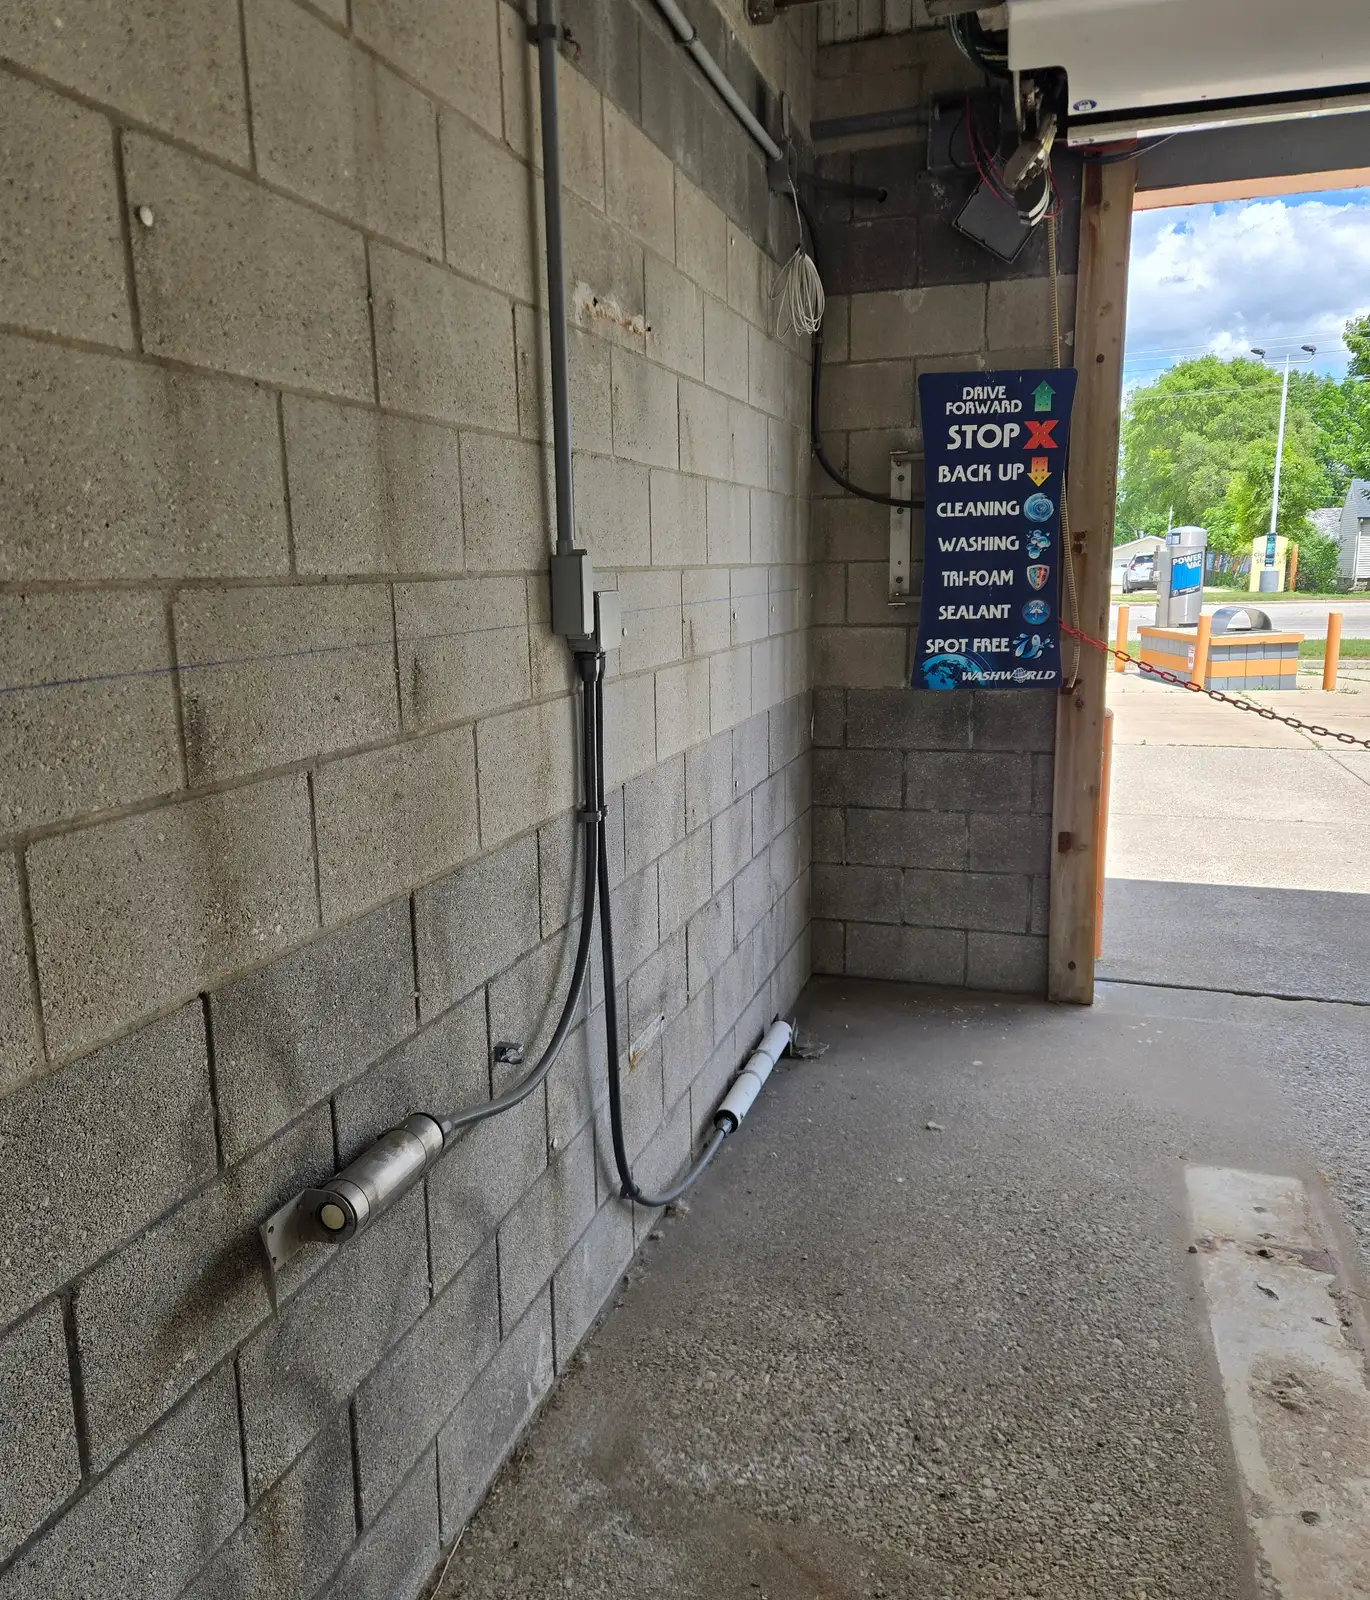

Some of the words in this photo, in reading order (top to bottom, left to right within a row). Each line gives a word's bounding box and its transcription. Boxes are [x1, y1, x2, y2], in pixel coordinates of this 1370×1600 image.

[963, 386, 1007, 400] DRIVE
[946, 400, 1022, 415] FORWARD
[947, 423, 1020, 450] STOP
[938, 464, 992, 483] BACK
[999, 463, 1025, 481] UP
[937, 501, 1020, 517] CLEANING
[938, 536, 1019, 552] WASHING
[1173, 553, 1202, 566] POWER
[1187, 560, 1202, 569] VAC
[942, 570, 1014, 587] TRI-FOAM
[939, 605, 1011, 620] SEALANT
[926, 639, 968, 653] SPOT
[973, 638, 1010, 652] FREE
[962, 668, 1056, 683] WASHWORLD
